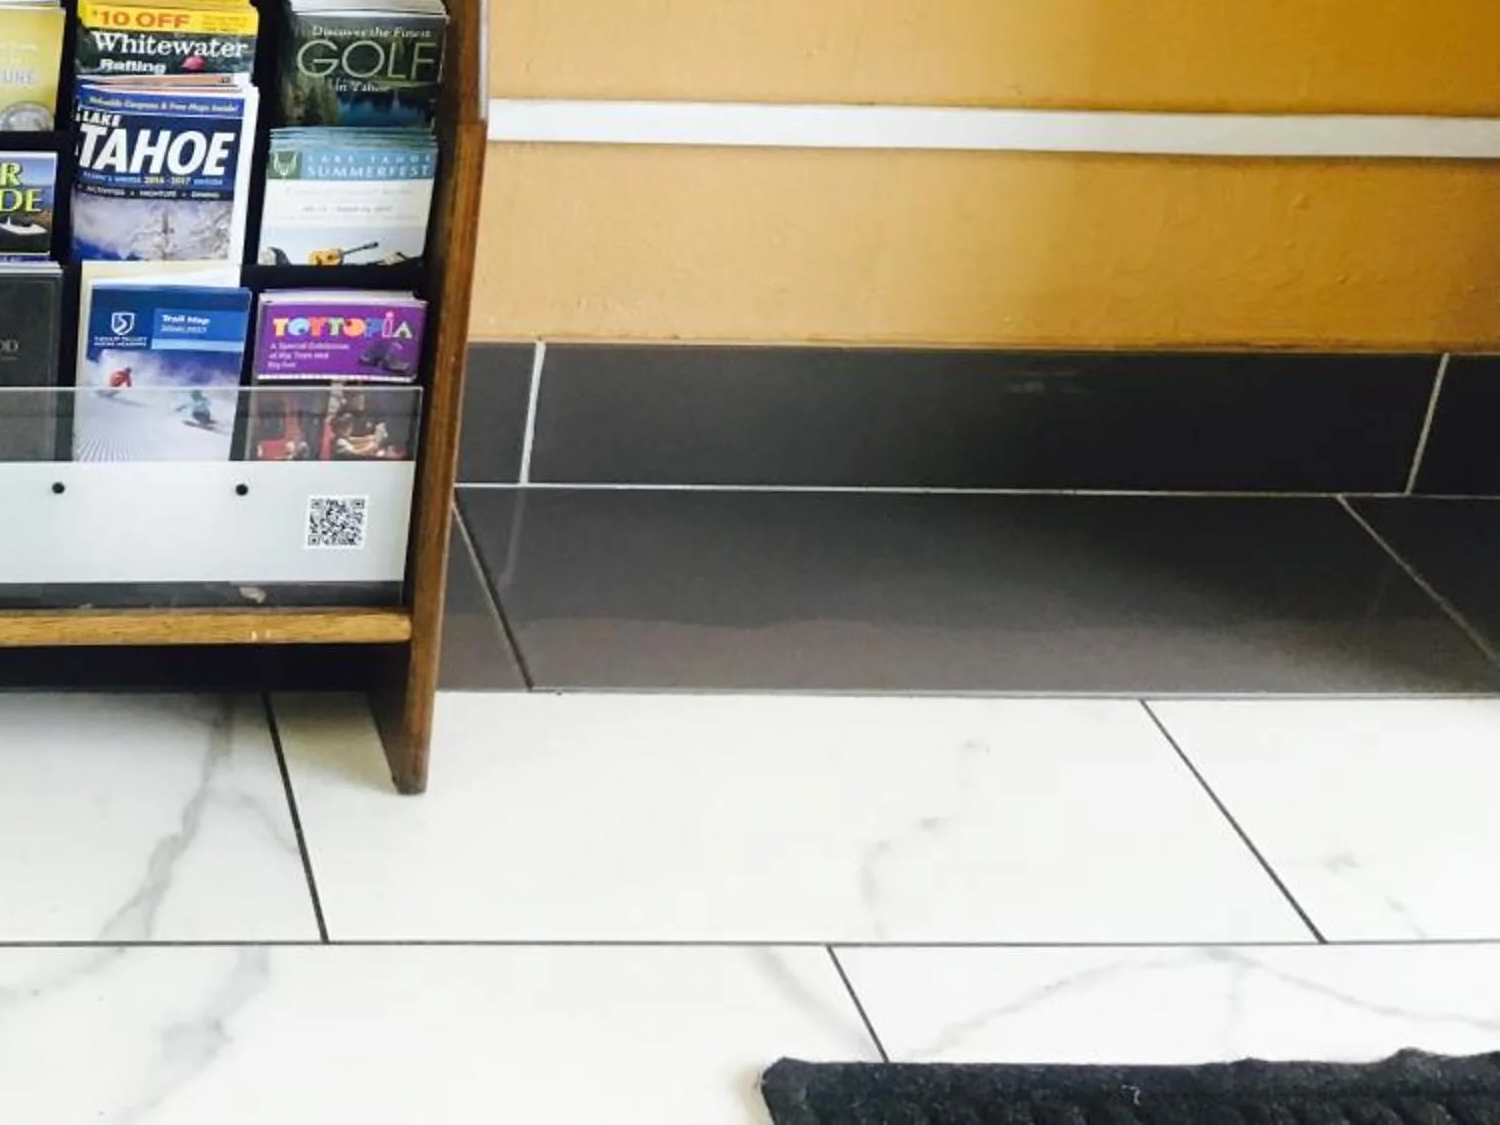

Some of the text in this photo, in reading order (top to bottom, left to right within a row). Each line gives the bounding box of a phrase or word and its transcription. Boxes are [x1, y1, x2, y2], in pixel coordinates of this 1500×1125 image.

[92, 31, 248, 58] Whitewater
[297, 39, 436, 78] GOLF
[82, 111, 122, 127] LAKE
[79, 130, 235, 176] TAHOE
[307, 165, 430, 177] SUMMERFEST
